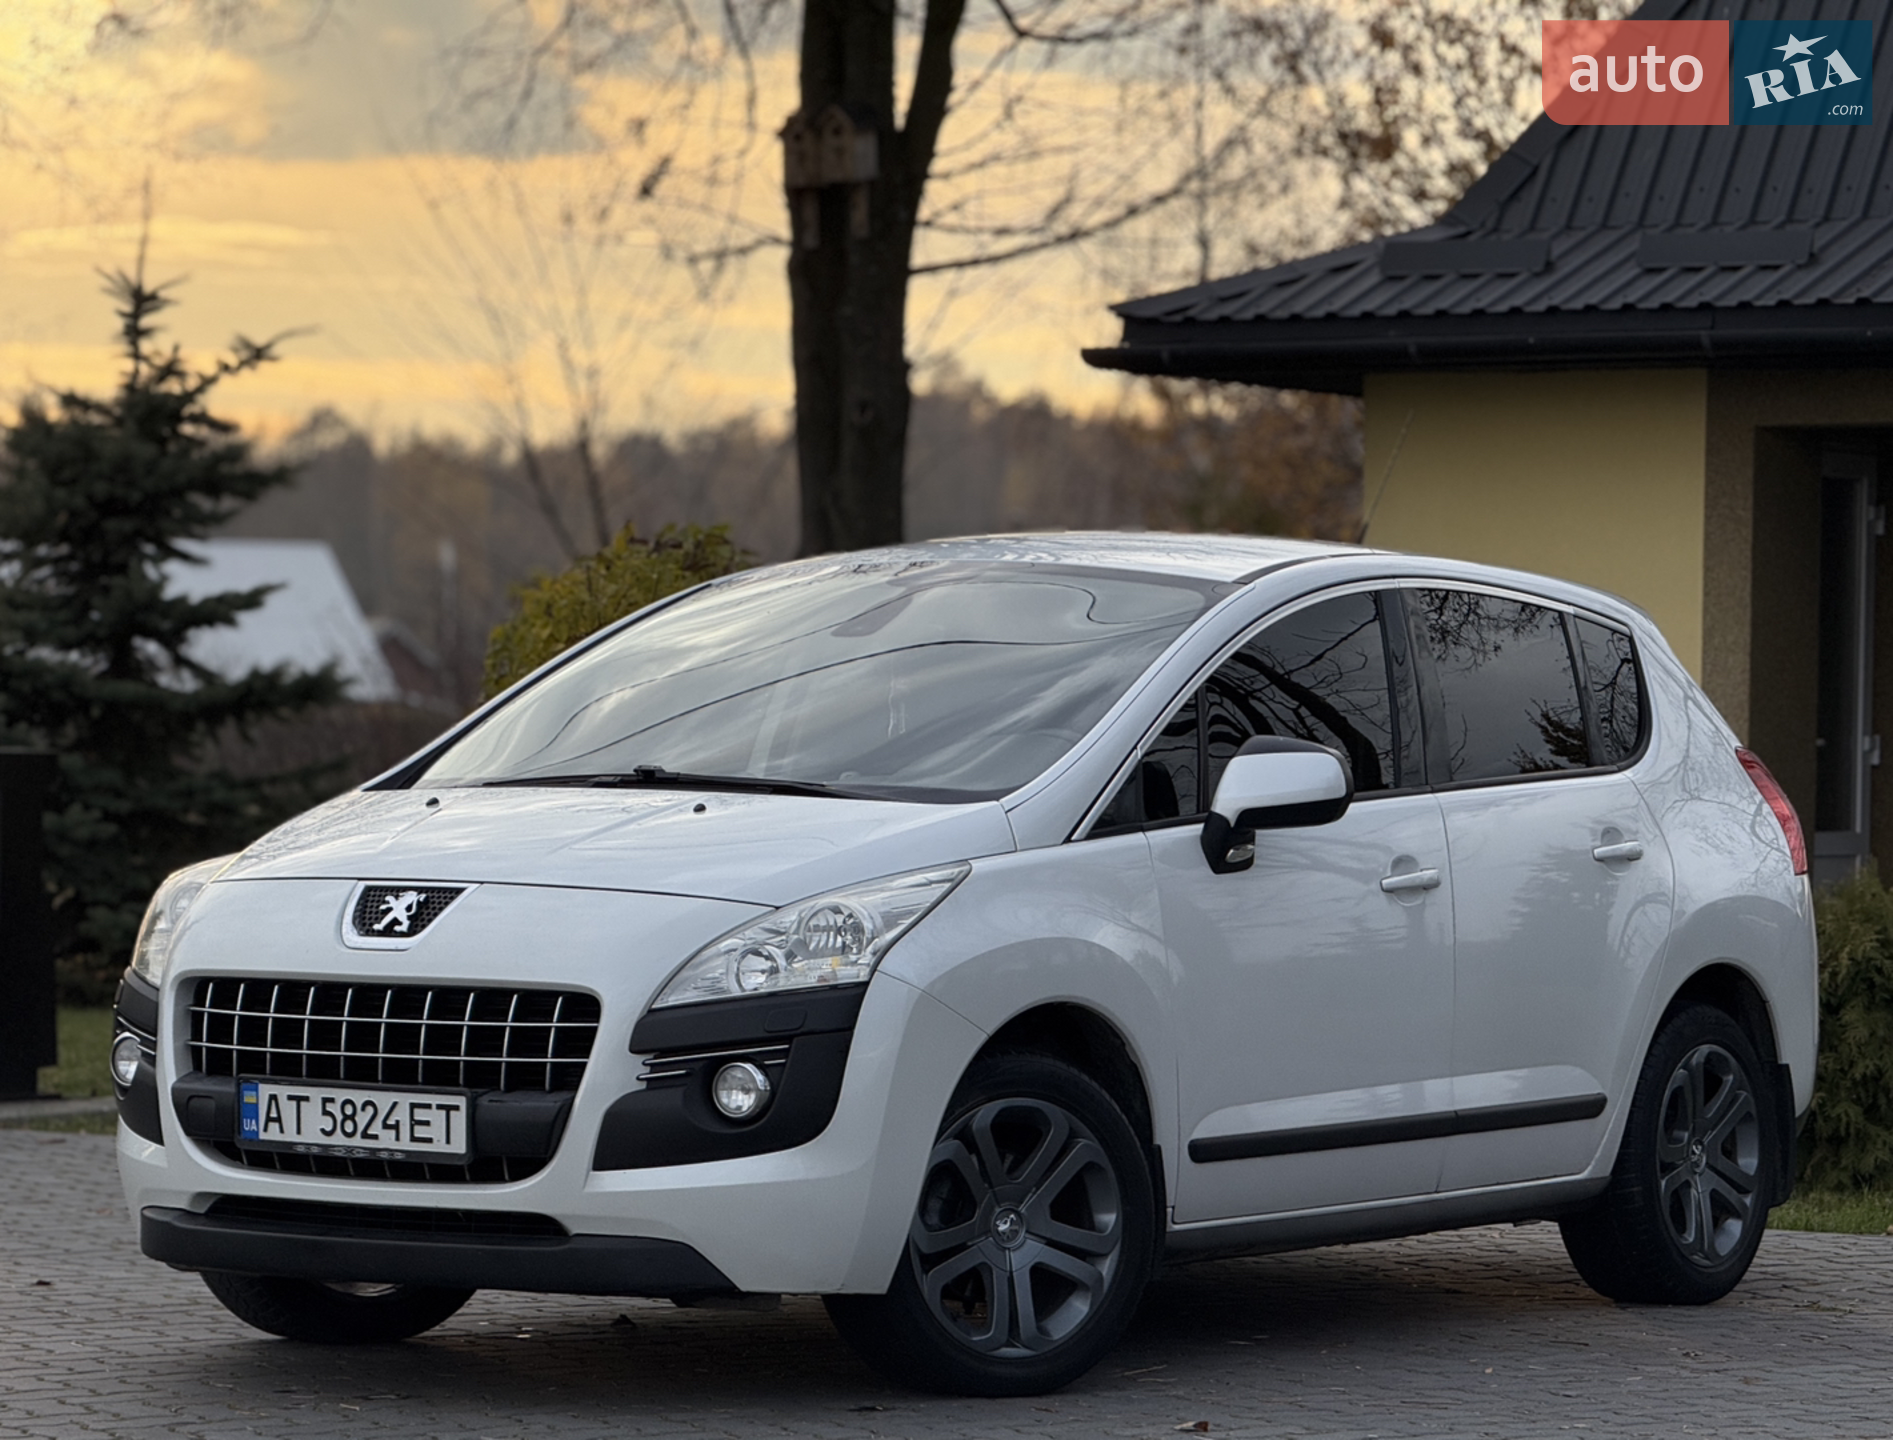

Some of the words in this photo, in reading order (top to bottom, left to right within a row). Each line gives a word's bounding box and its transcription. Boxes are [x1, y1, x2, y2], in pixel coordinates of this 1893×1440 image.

[243, 1118, 258, 1132] UA
[262, 1093, 310, 1136] AT
[319, 1096, 401, 1142] 5824
[409, 1102, 461, 1145] ET
